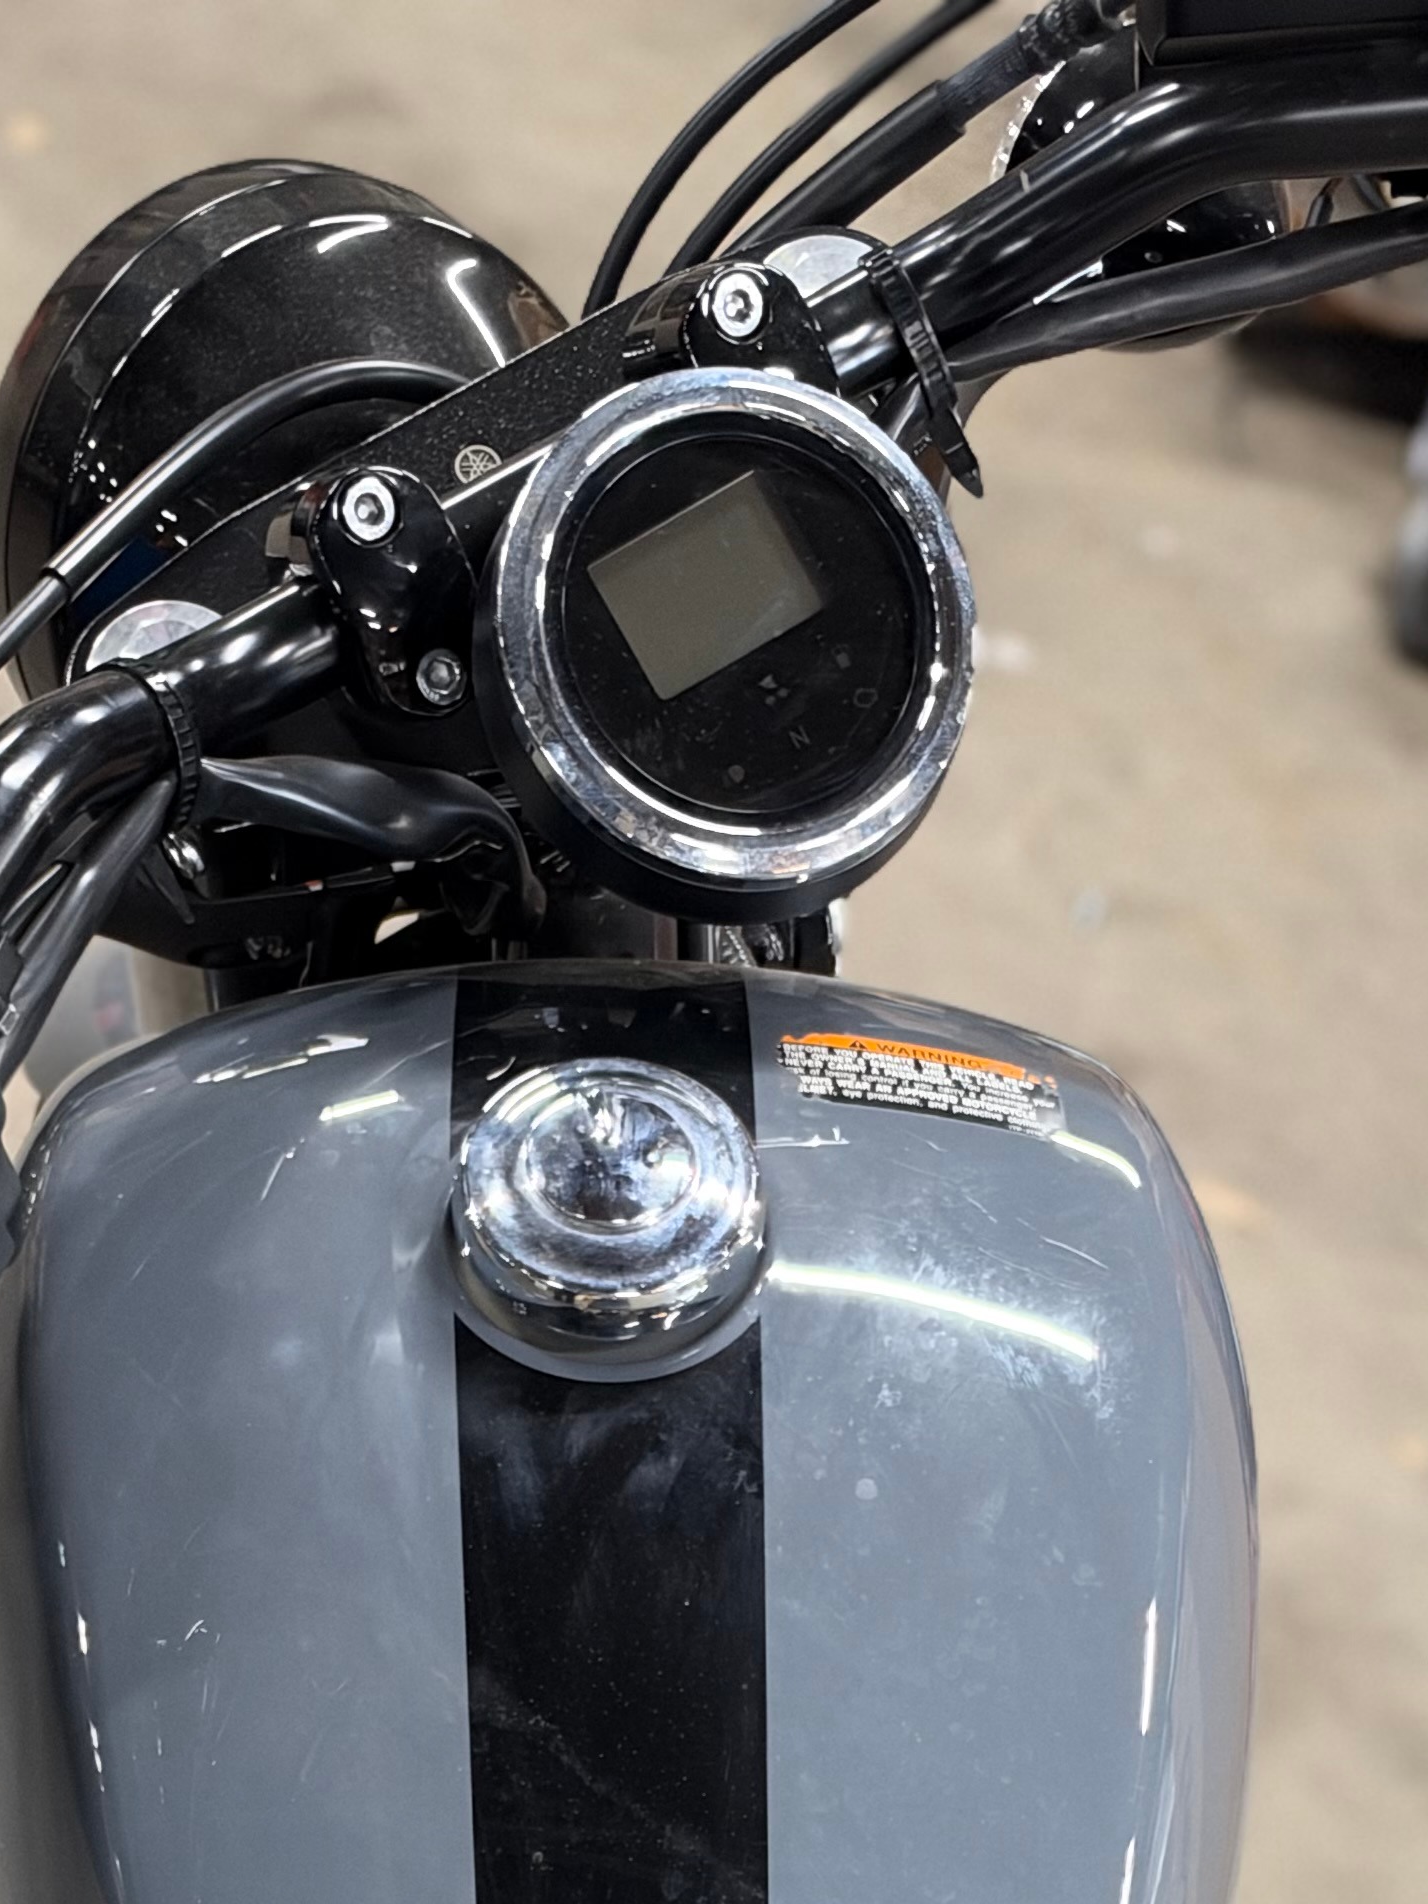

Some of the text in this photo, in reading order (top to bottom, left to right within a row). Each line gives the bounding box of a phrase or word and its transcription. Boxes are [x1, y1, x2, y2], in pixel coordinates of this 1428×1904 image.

[789, 725, 810, 749] N
[833, 1048, 857, 1057] YOU
[877, 1044, 982, 1067] WARNING
[785, 1058, 823, 1068] NEVER
[828, 1062, 866, 1073] CARRY
[861, 1074, 897, 1084] control
[842, 1089, 862, 1099] eye
[927, 1101, 948, 1111] and
